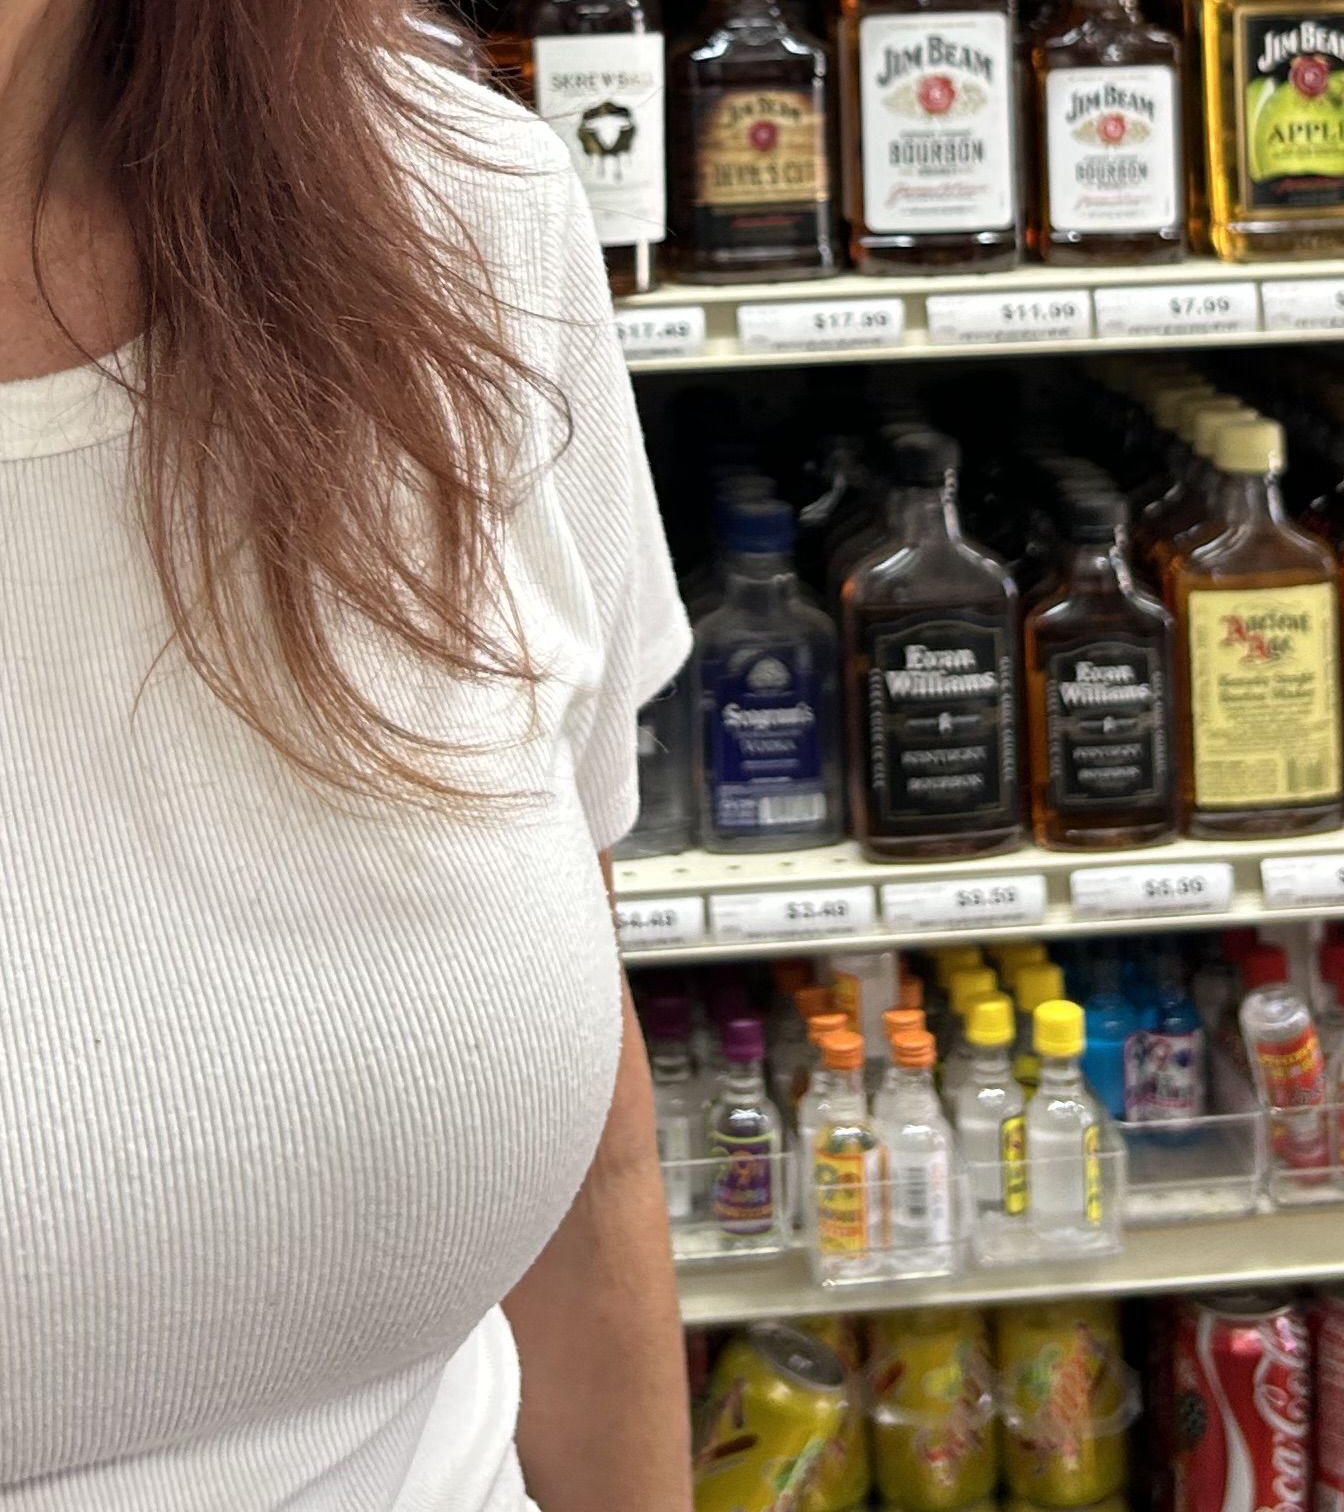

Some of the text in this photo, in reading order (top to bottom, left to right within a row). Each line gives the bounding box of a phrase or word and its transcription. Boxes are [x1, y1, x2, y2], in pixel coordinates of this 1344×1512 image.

[877, 33, 993, 86] JIM BEAM
[1258, 31, 1301, 72] JIM
[1066, 83, 1155, 124] JIM BEAM
[889, 140, 984, 165] BOURBON
[1076, 162, 1148, 181] BOURBON
[885, 670, 1000, 700] Williams
[1058, 681, 1153, 707] Williams
